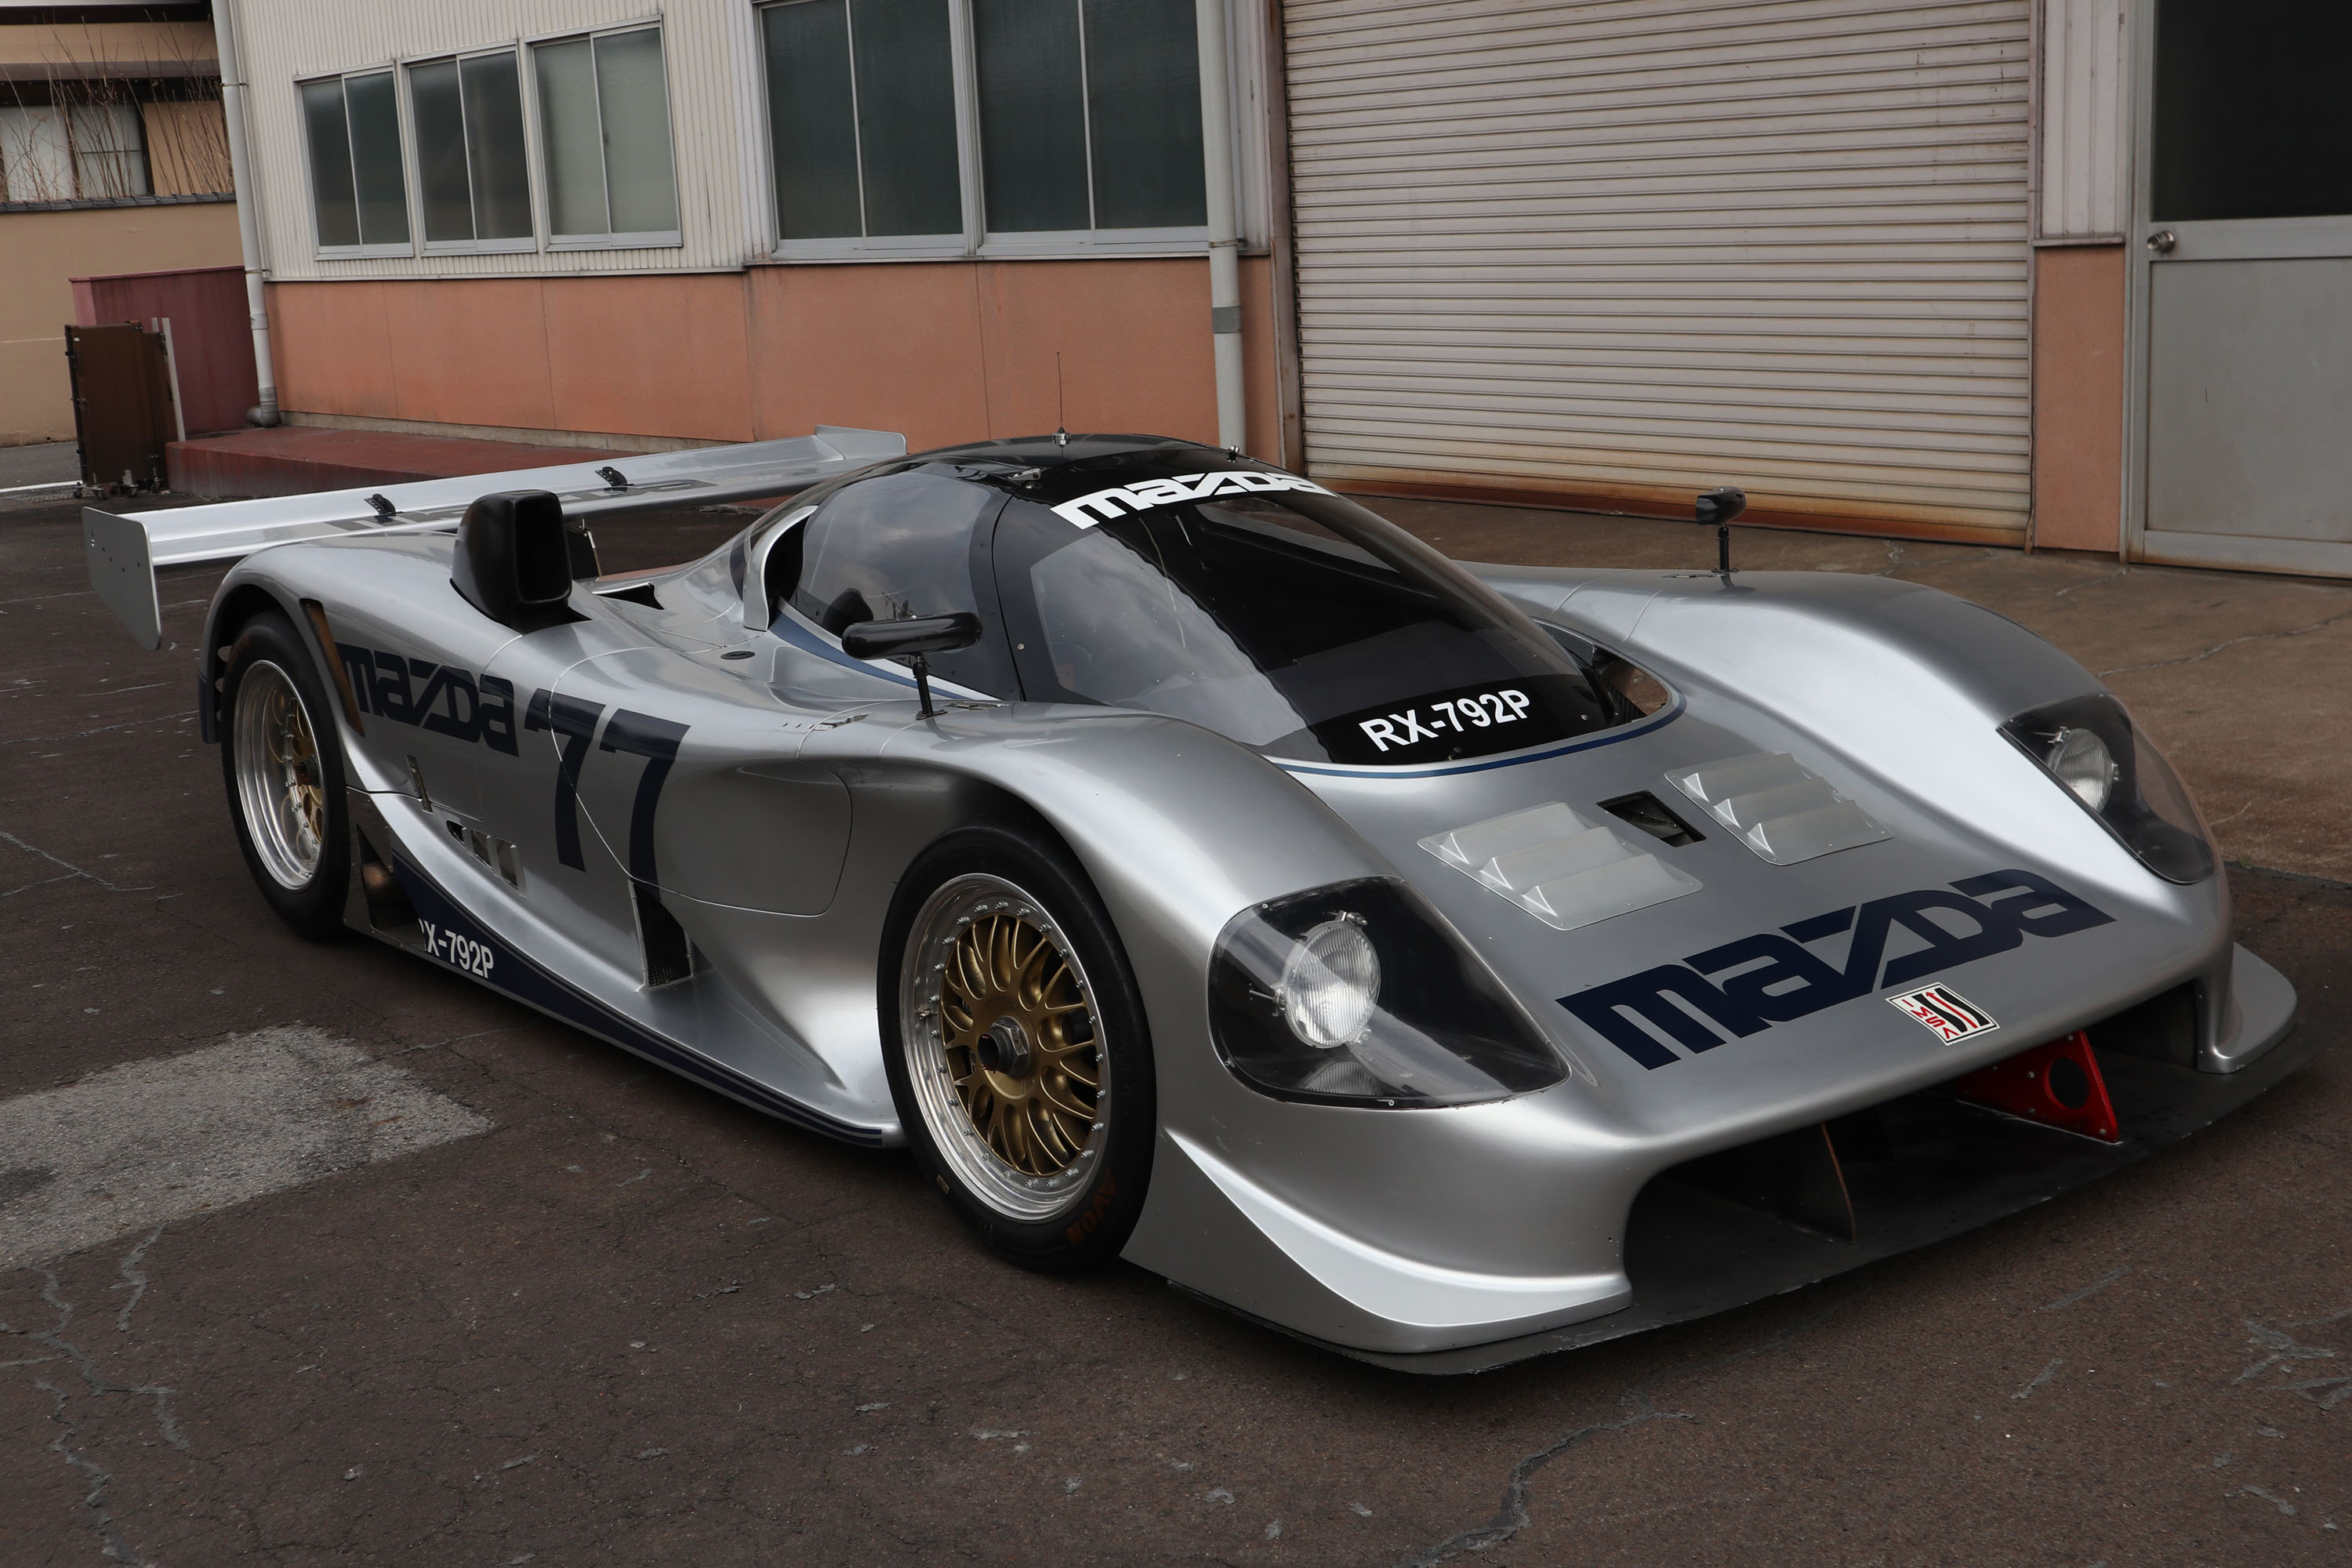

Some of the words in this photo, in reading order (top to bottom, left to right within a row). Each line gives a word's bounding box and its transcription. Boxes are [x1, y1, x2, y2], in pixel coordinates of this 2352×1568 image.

[1358, 688, 1530, 752] RX-792P
[524, 688, 691, 902] 77
[1902, 999, 1960, 1040] IMSA
[1065, 1166, 1118, 1247] AVON
